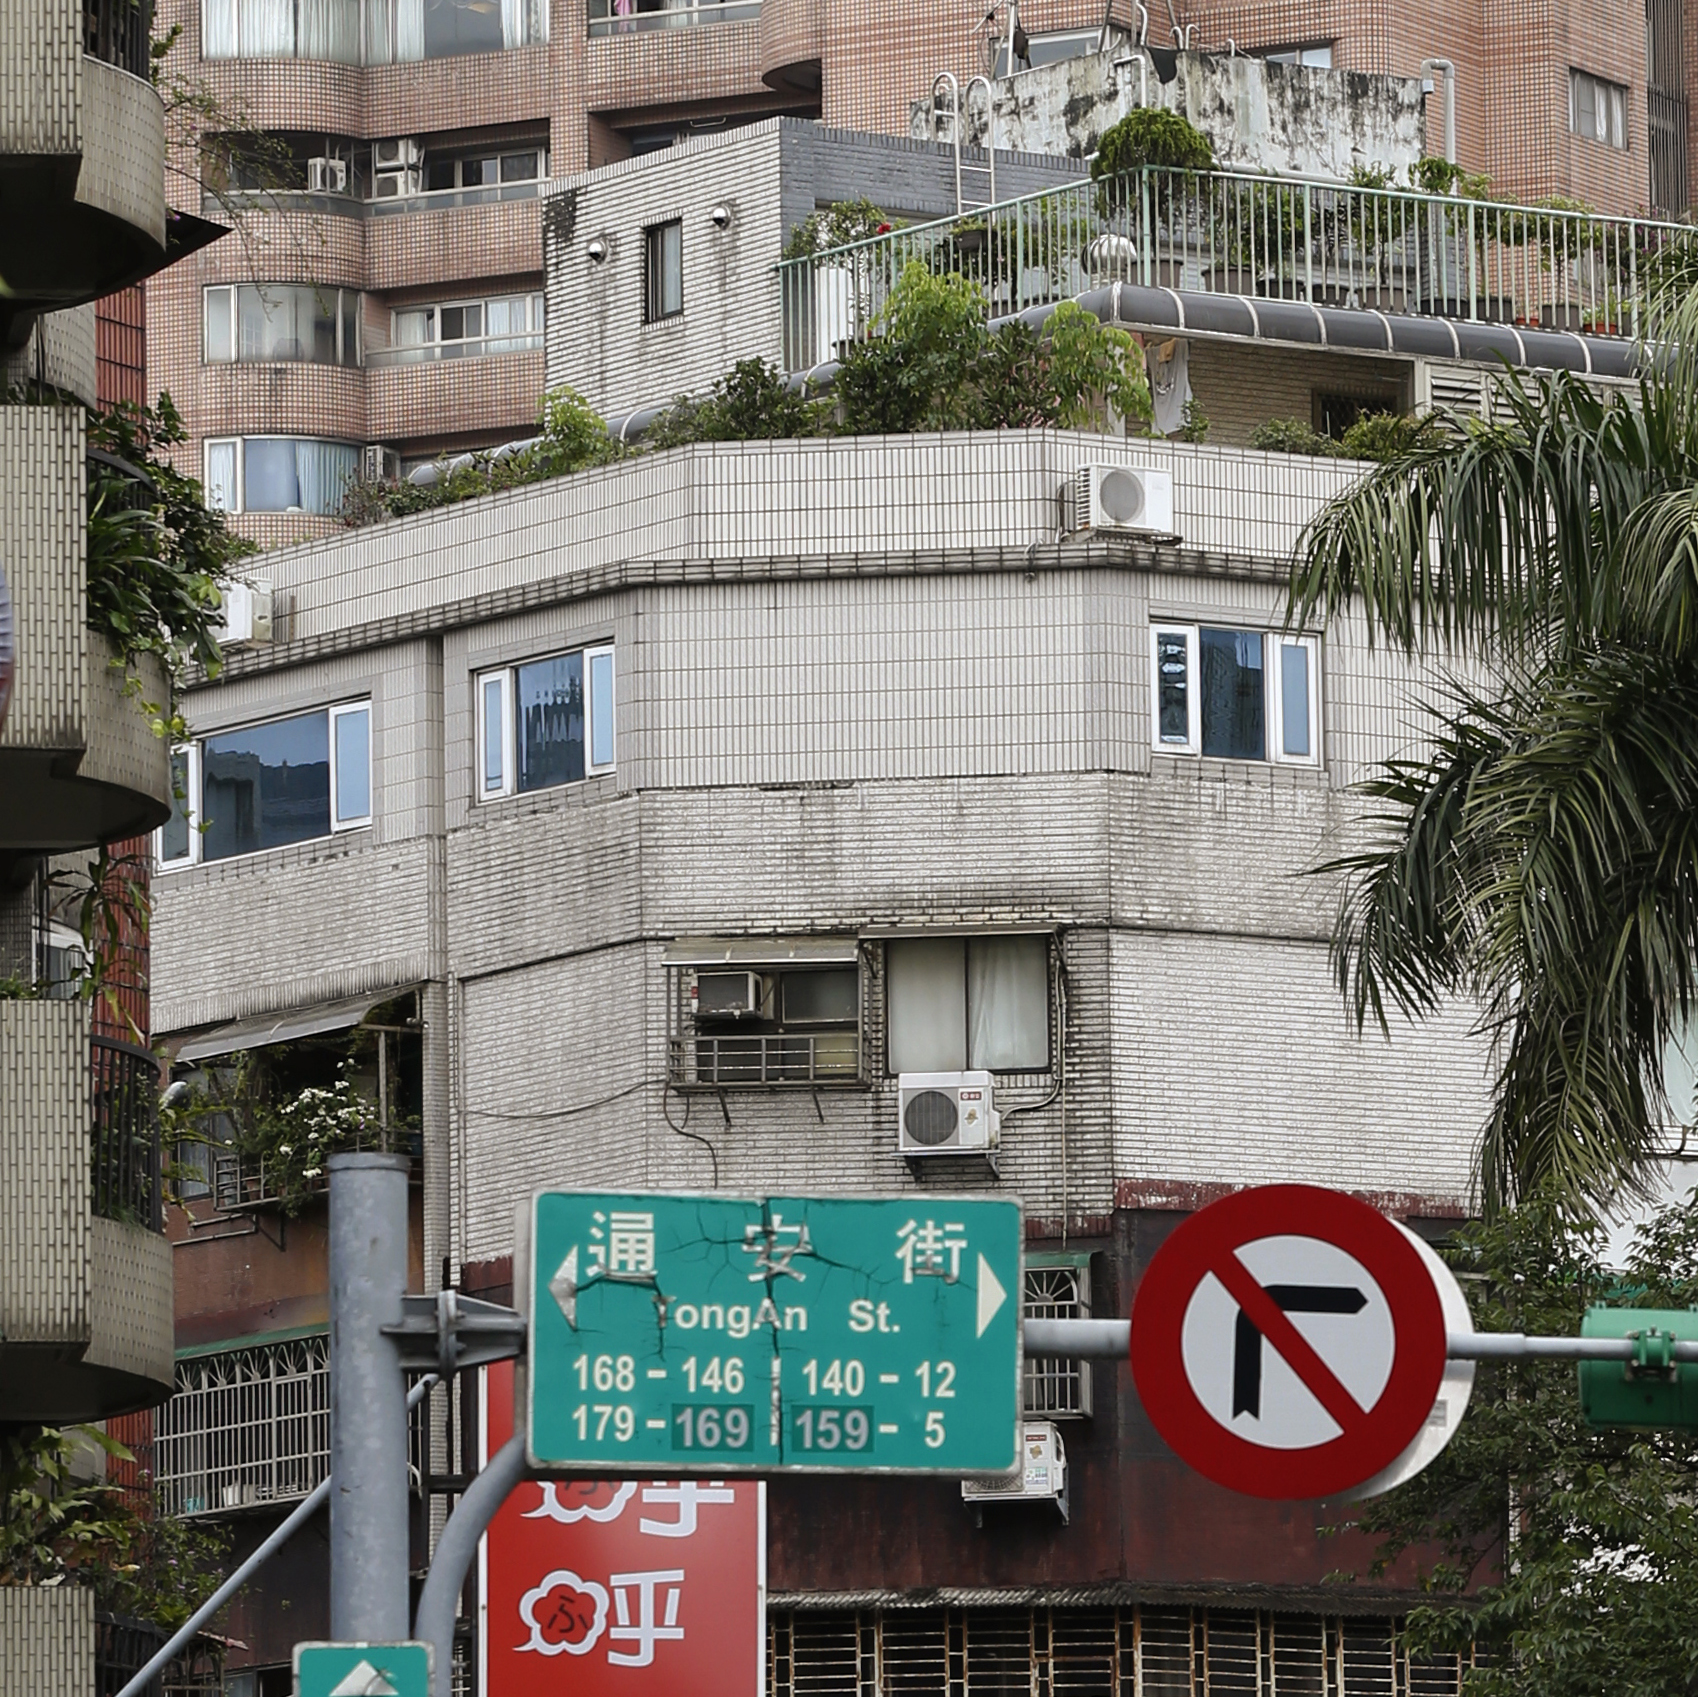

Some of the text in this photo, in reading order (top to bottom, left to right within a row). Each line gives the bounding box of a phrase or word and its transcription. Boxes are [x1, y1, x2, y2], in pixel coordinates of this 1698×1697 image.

[587, 1211, 968, 1286] 通安街
[848, 1299, 901, 1335] St.
